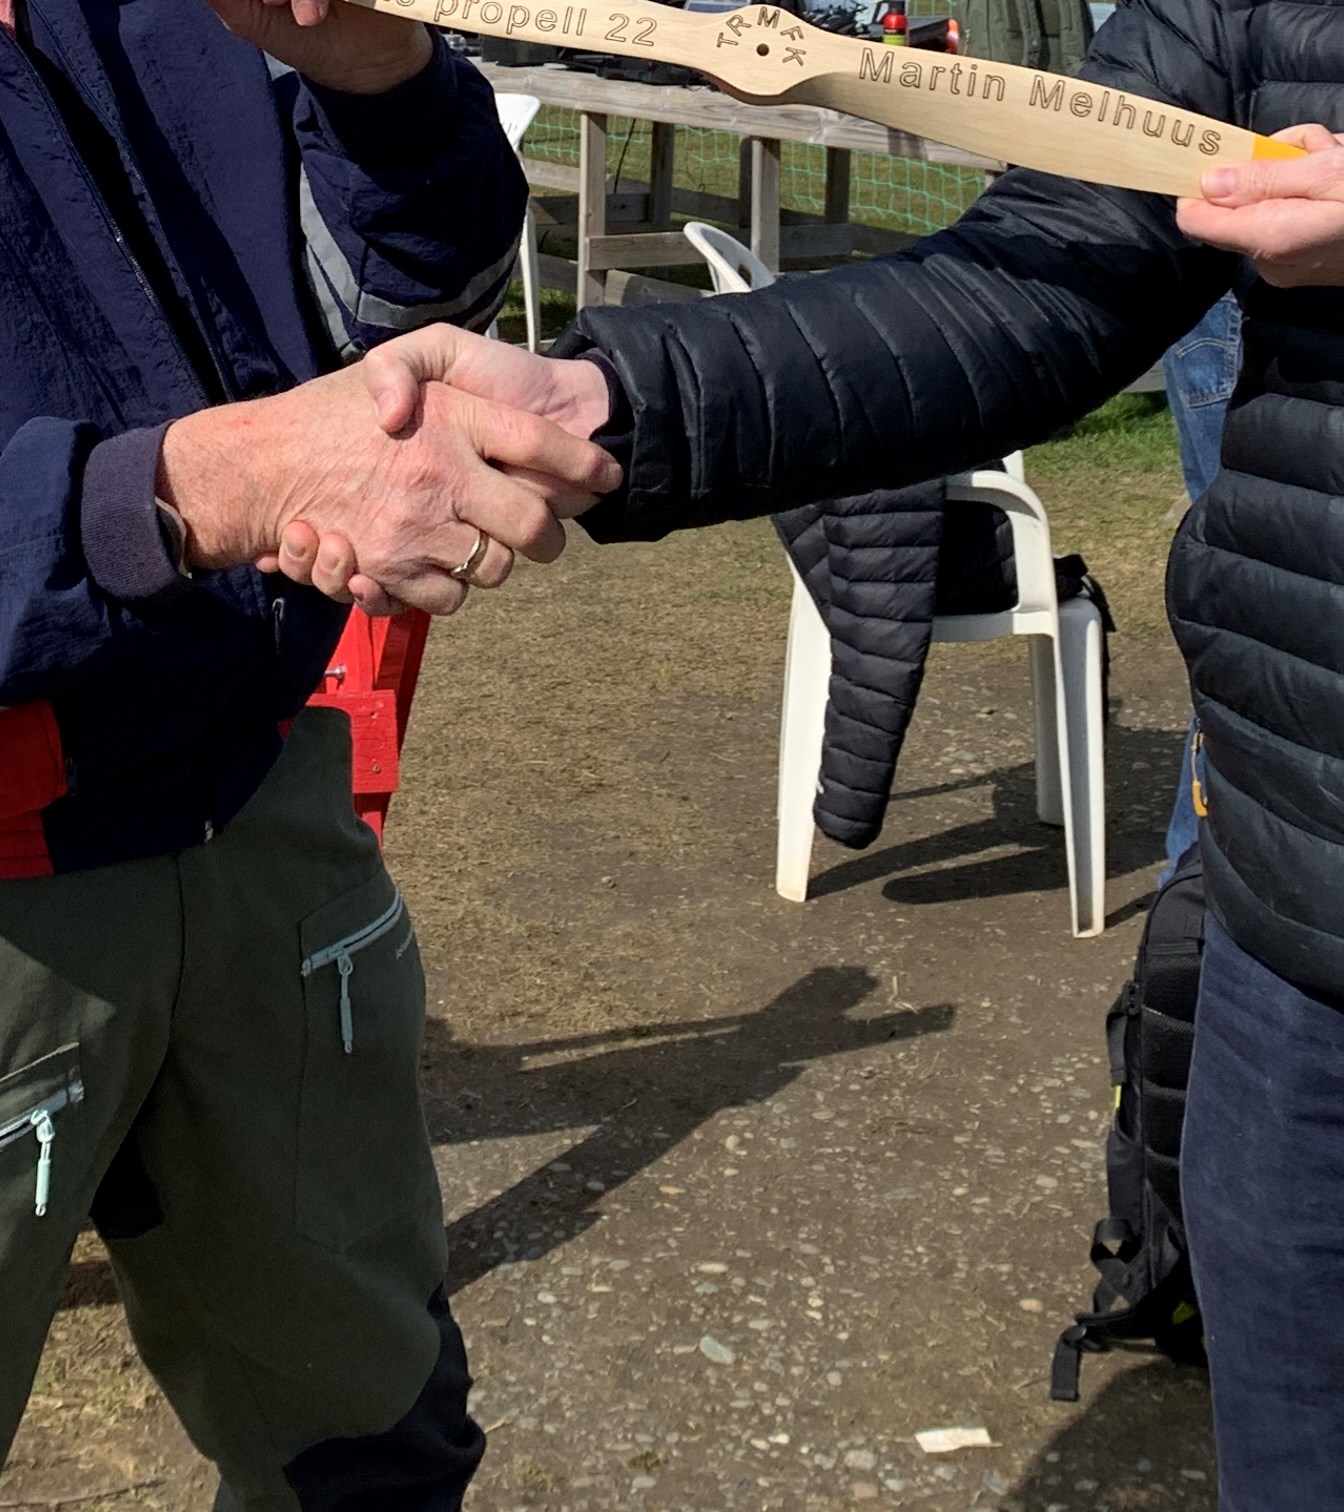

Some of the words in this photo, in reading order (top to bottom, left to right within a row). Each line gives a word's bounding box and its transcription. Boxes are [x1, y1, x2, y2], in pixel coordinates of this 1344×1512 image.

[605, 13, 658, 47] 22
[858, 47, 1006, 102] Martin
[1029, 75, 1222, 156] Melhuus
